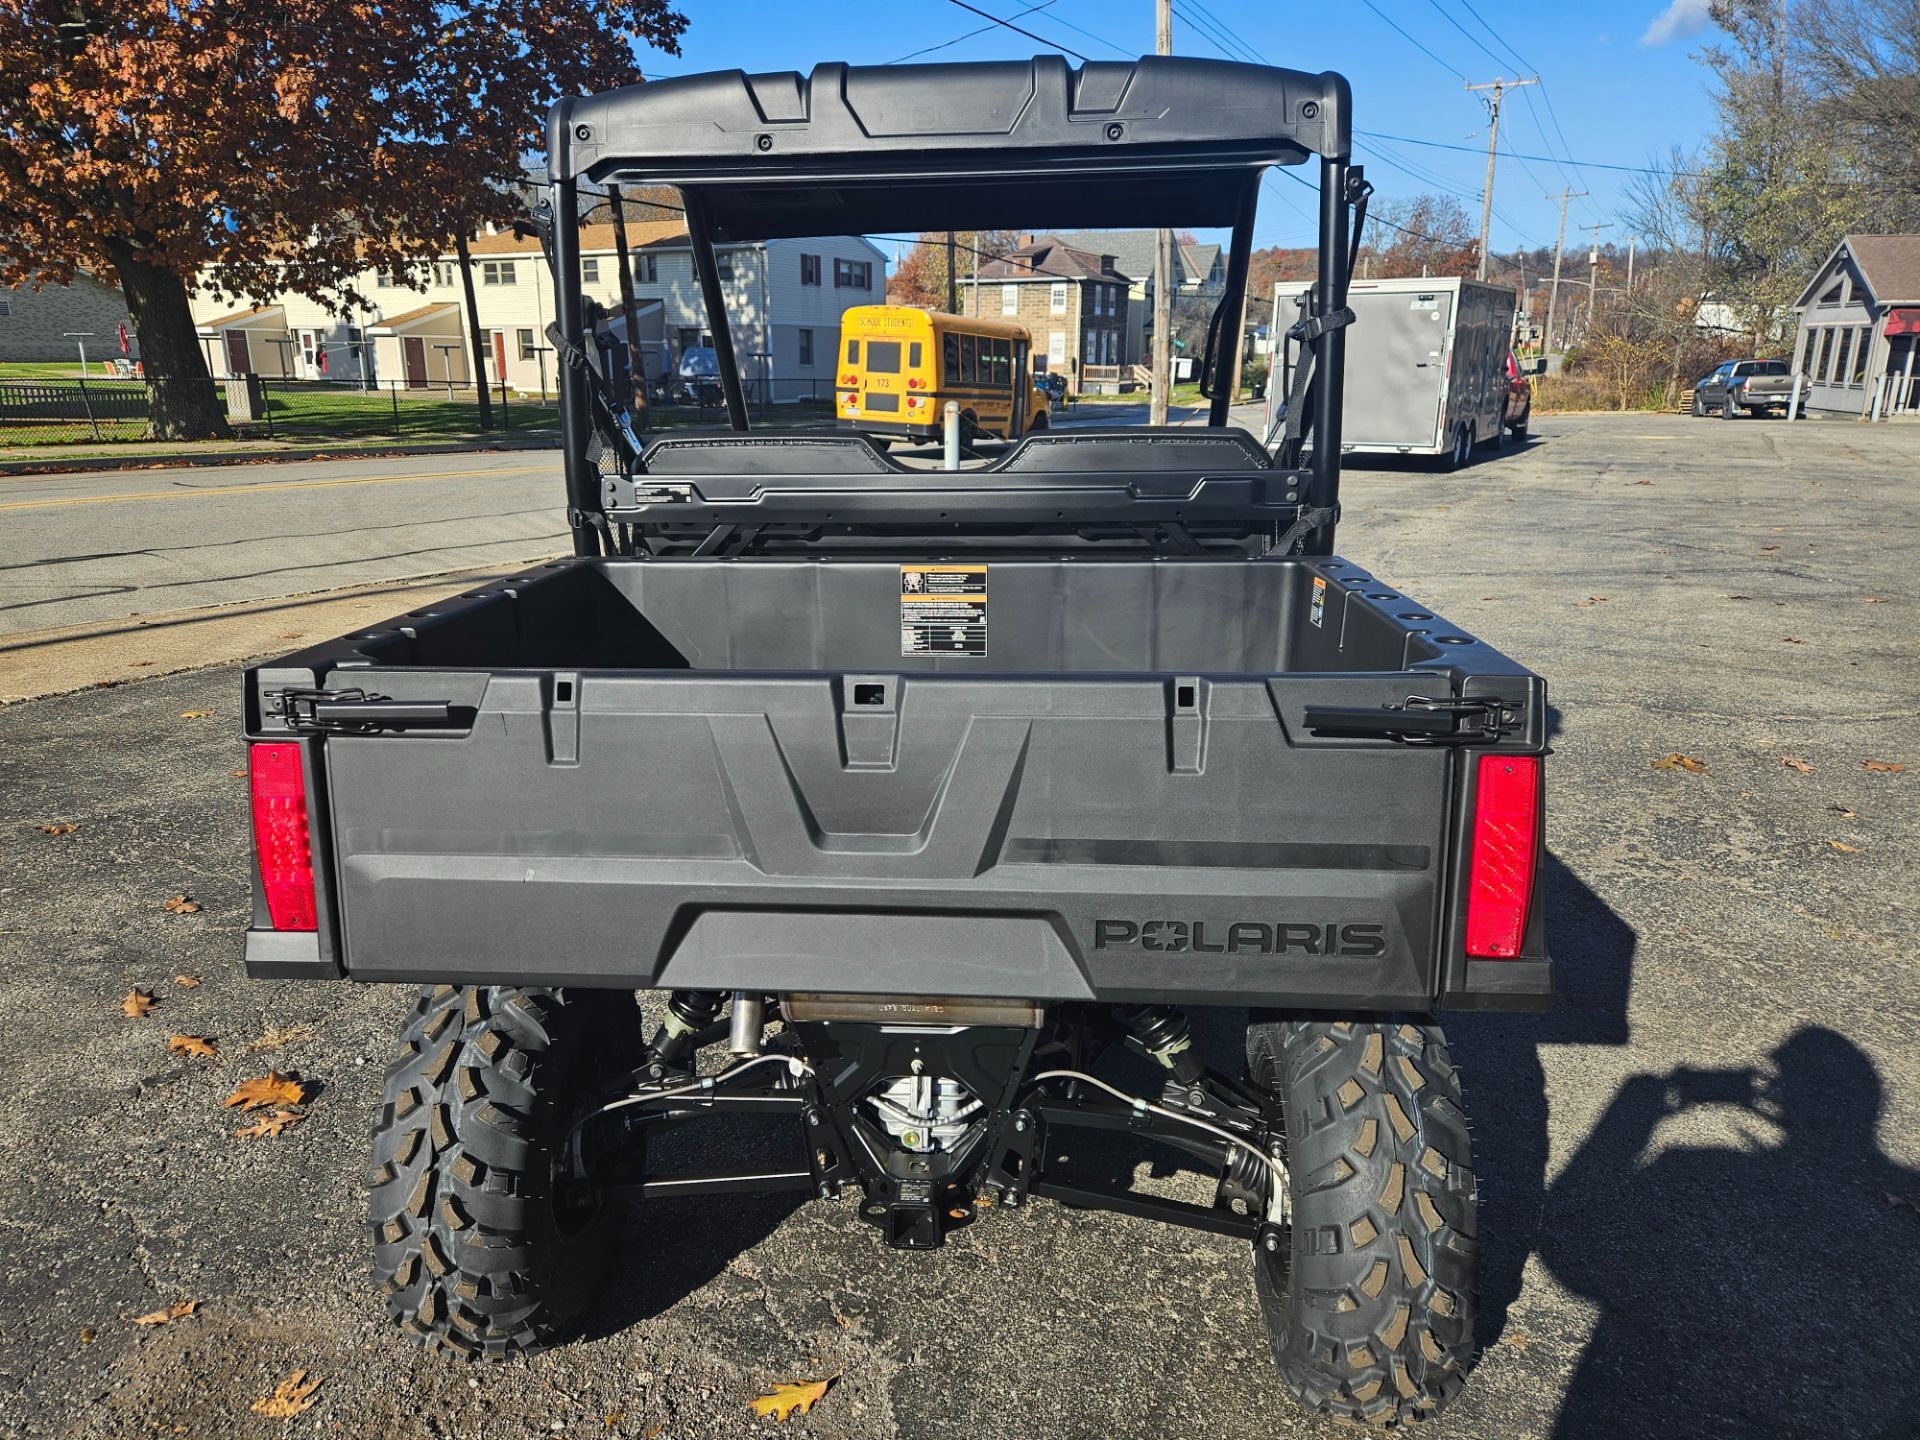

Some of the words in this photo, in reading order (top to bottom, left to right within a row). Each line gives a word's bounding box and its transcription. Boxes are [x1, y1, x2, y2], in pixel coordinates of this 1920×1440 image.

[860, 316, 881, 327] SCHOOL
[883, 317, 912, 328] STUDENTS
[877, 379, 890, 388] 173
[1095, 919, 1386, 956] POLARIS
